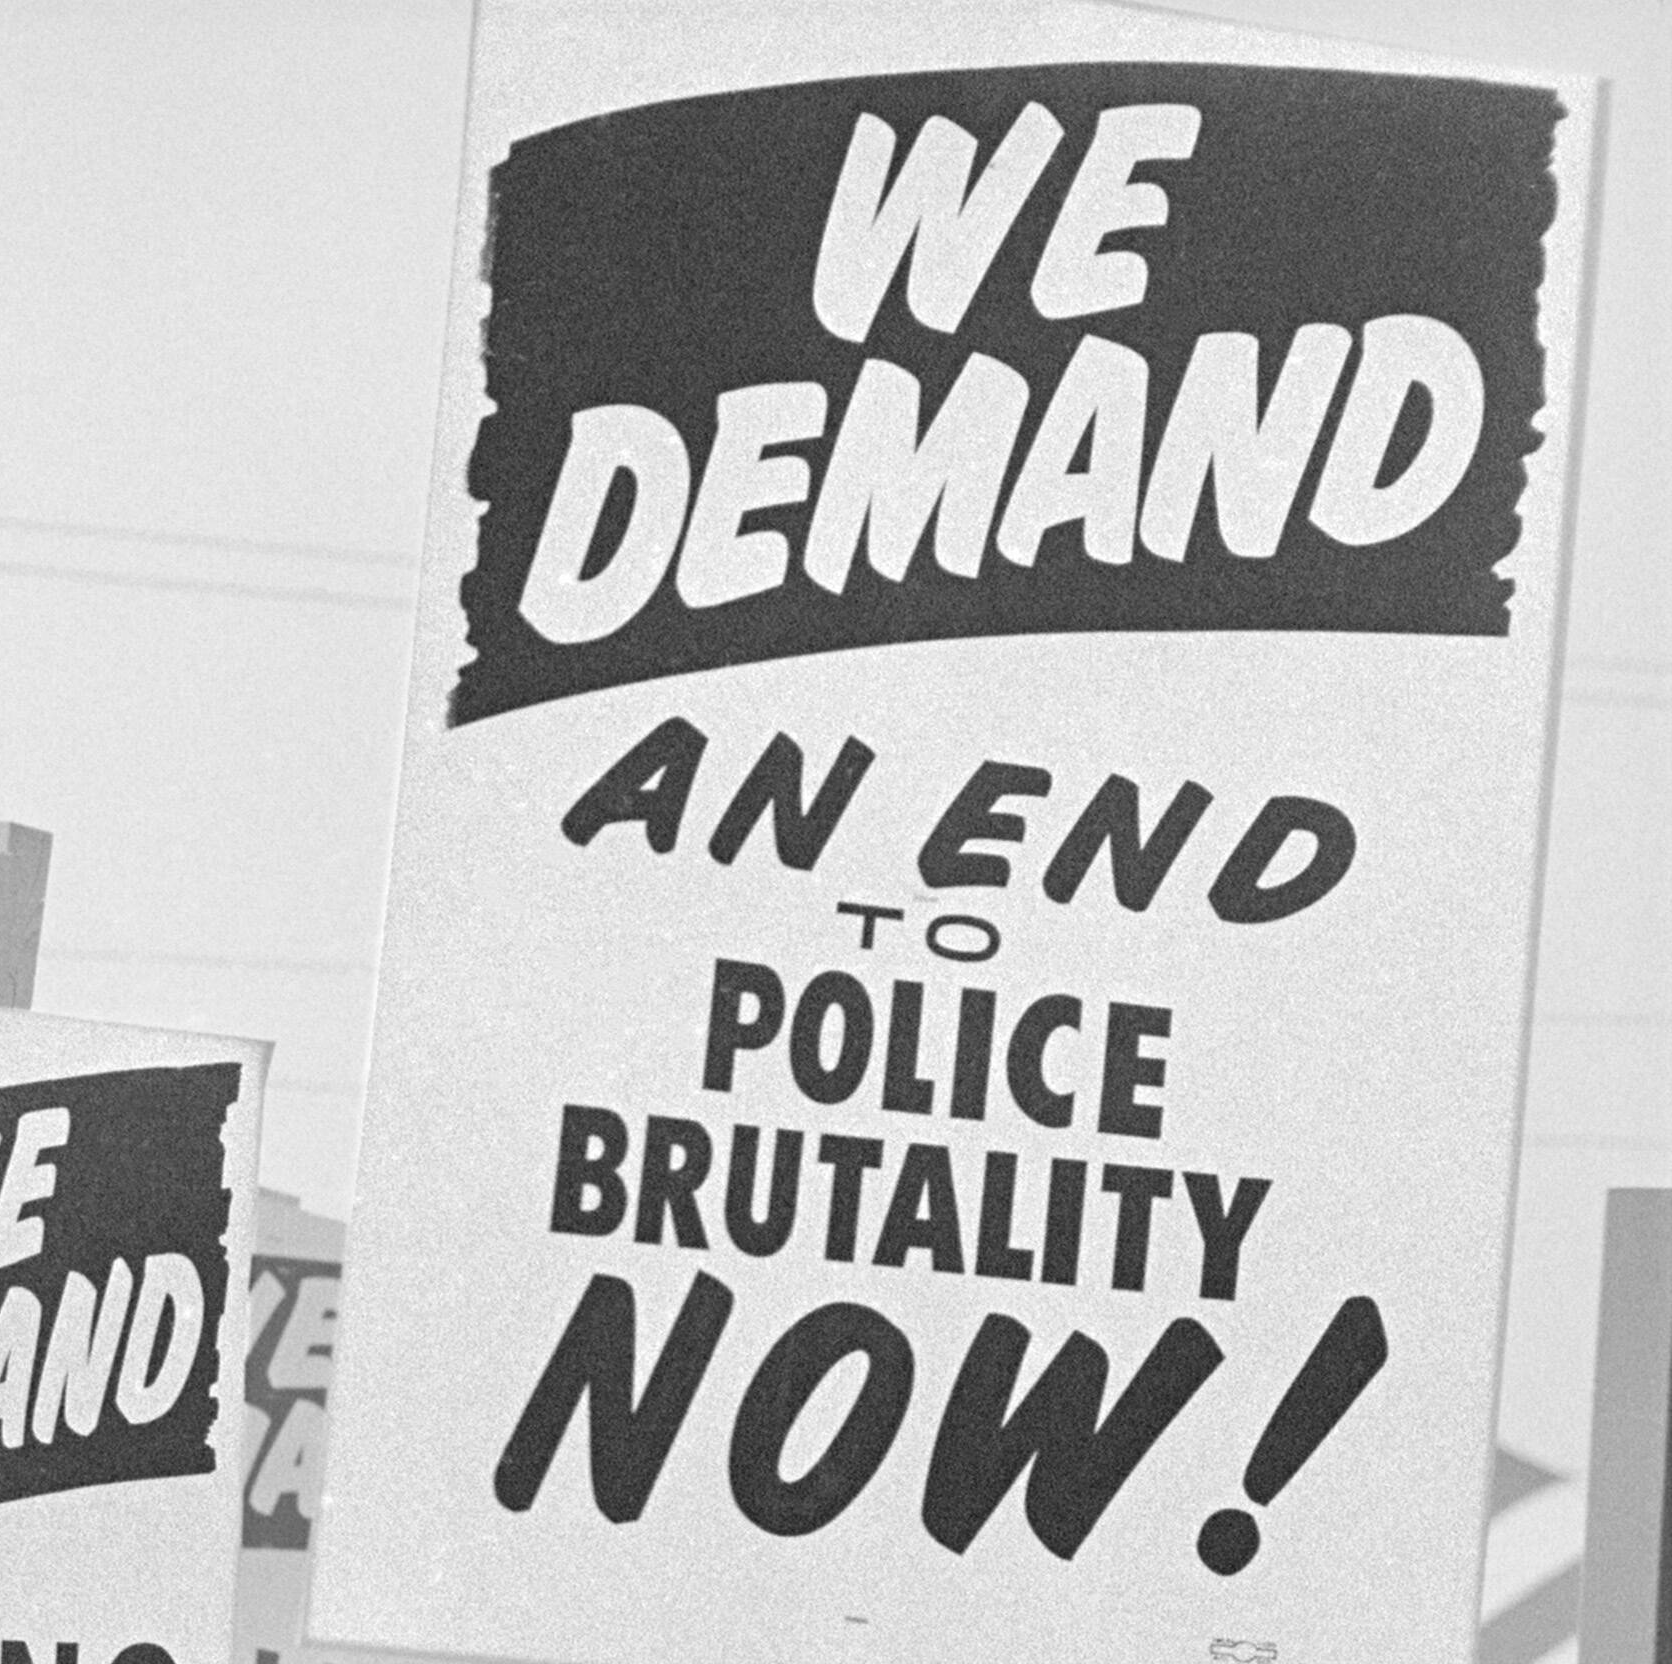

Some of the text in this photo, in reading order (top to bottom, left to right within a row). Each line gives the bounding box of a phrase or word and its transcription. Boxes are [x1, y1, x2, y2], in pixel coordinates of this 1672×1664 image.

[811, 100, 1203, 345] WE
[518, 313, 1486, 645] DEMAND
[562, 717, 1357, 924] AN END
[837, 902, 1000, 962] TO
[703, 959, 1171, 1139] POLICE
[550, 1105, 1271, 1301] BRUTALITY
[496, 1271, 1388, 1576] NOW!
